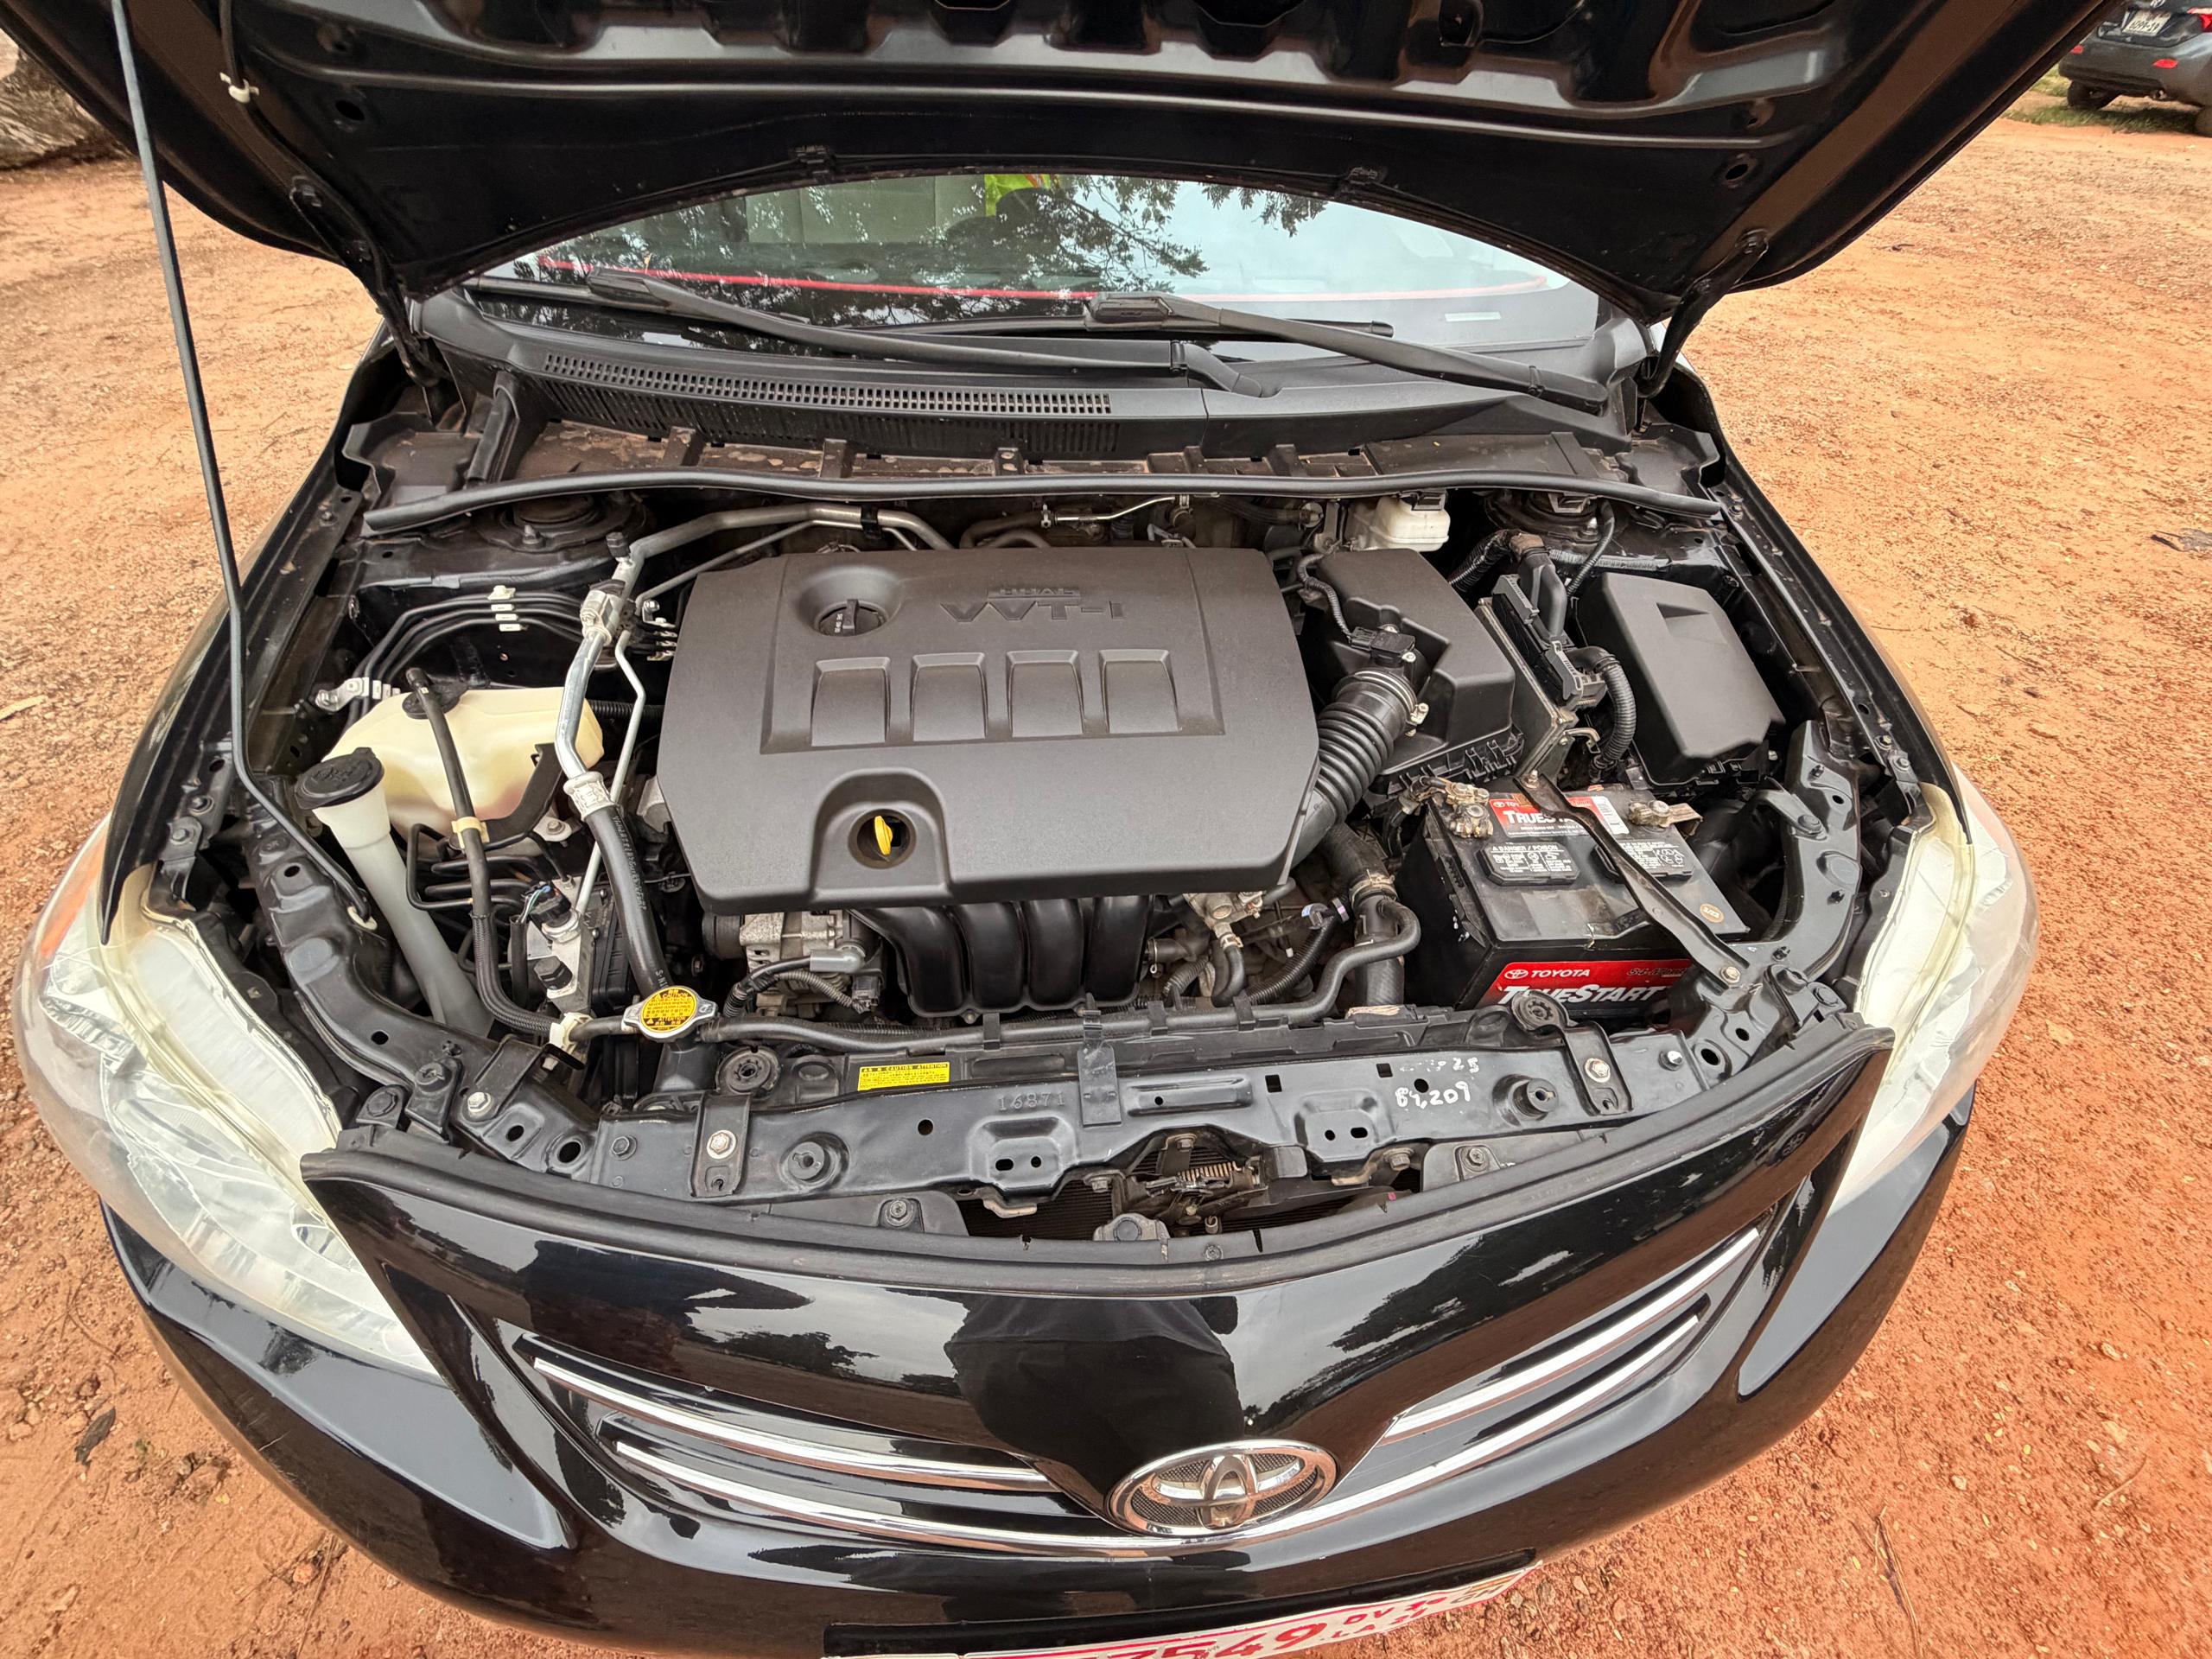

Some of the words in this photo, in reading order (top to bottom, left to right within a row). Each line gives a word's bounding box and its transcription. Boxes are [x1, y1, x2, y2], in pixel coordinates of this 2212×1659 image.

[1530, 969, 1591, 978] TOYOTA
[999, 1092, 1065, 1111] 16871
[1343, 1607, 1395, 1625] DV
